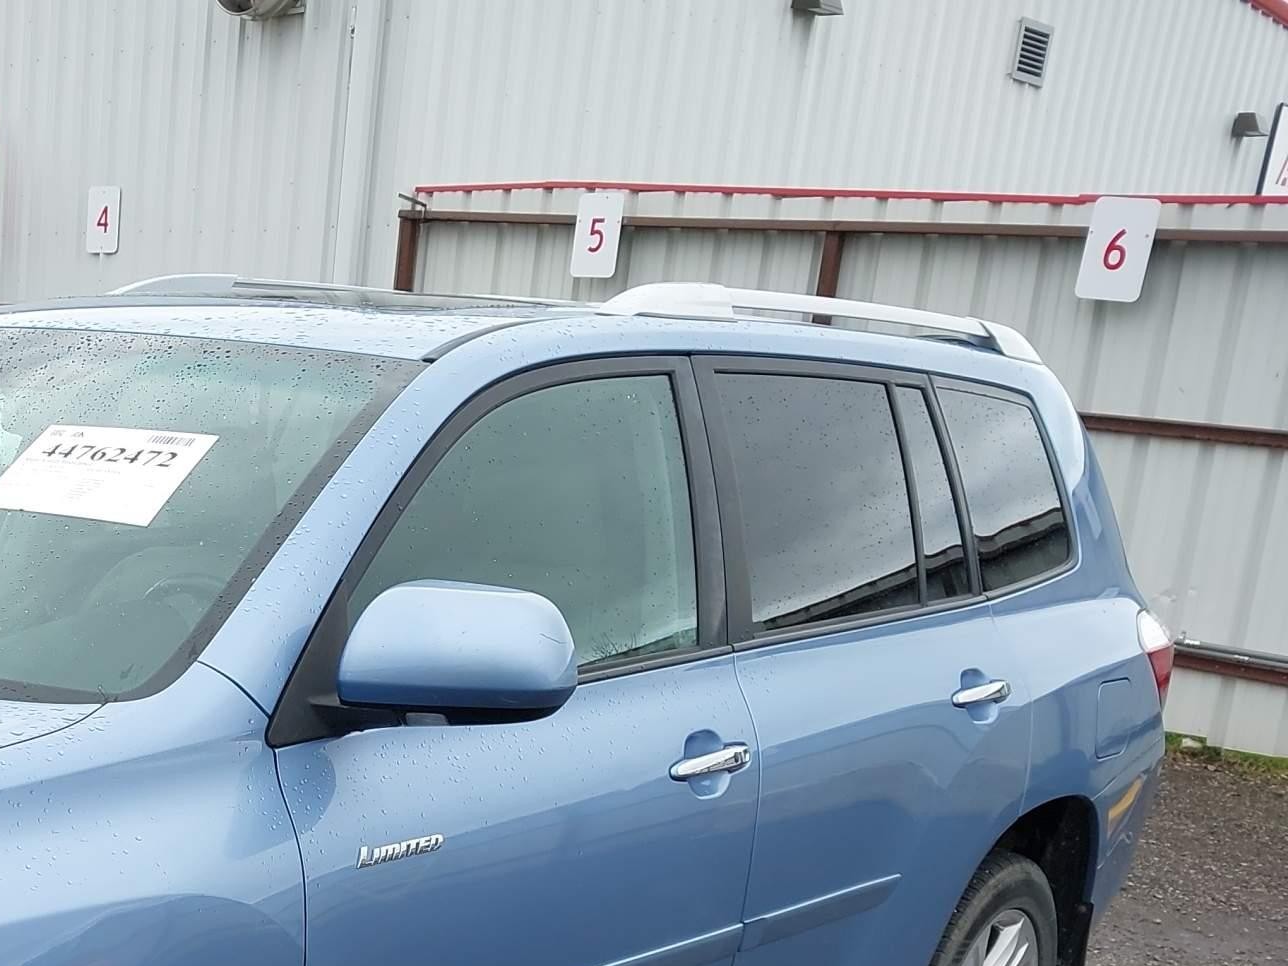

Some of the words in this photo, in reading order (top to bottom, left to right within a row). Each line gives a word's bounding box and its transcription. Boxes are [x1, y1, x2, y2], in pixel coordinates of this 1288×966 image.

[96, 205, 109, 233] 4
[587, 218, 605, 253] 5
[1103, 228, 1128, 271] 6
[41, 443, 178, 467] 44762472
